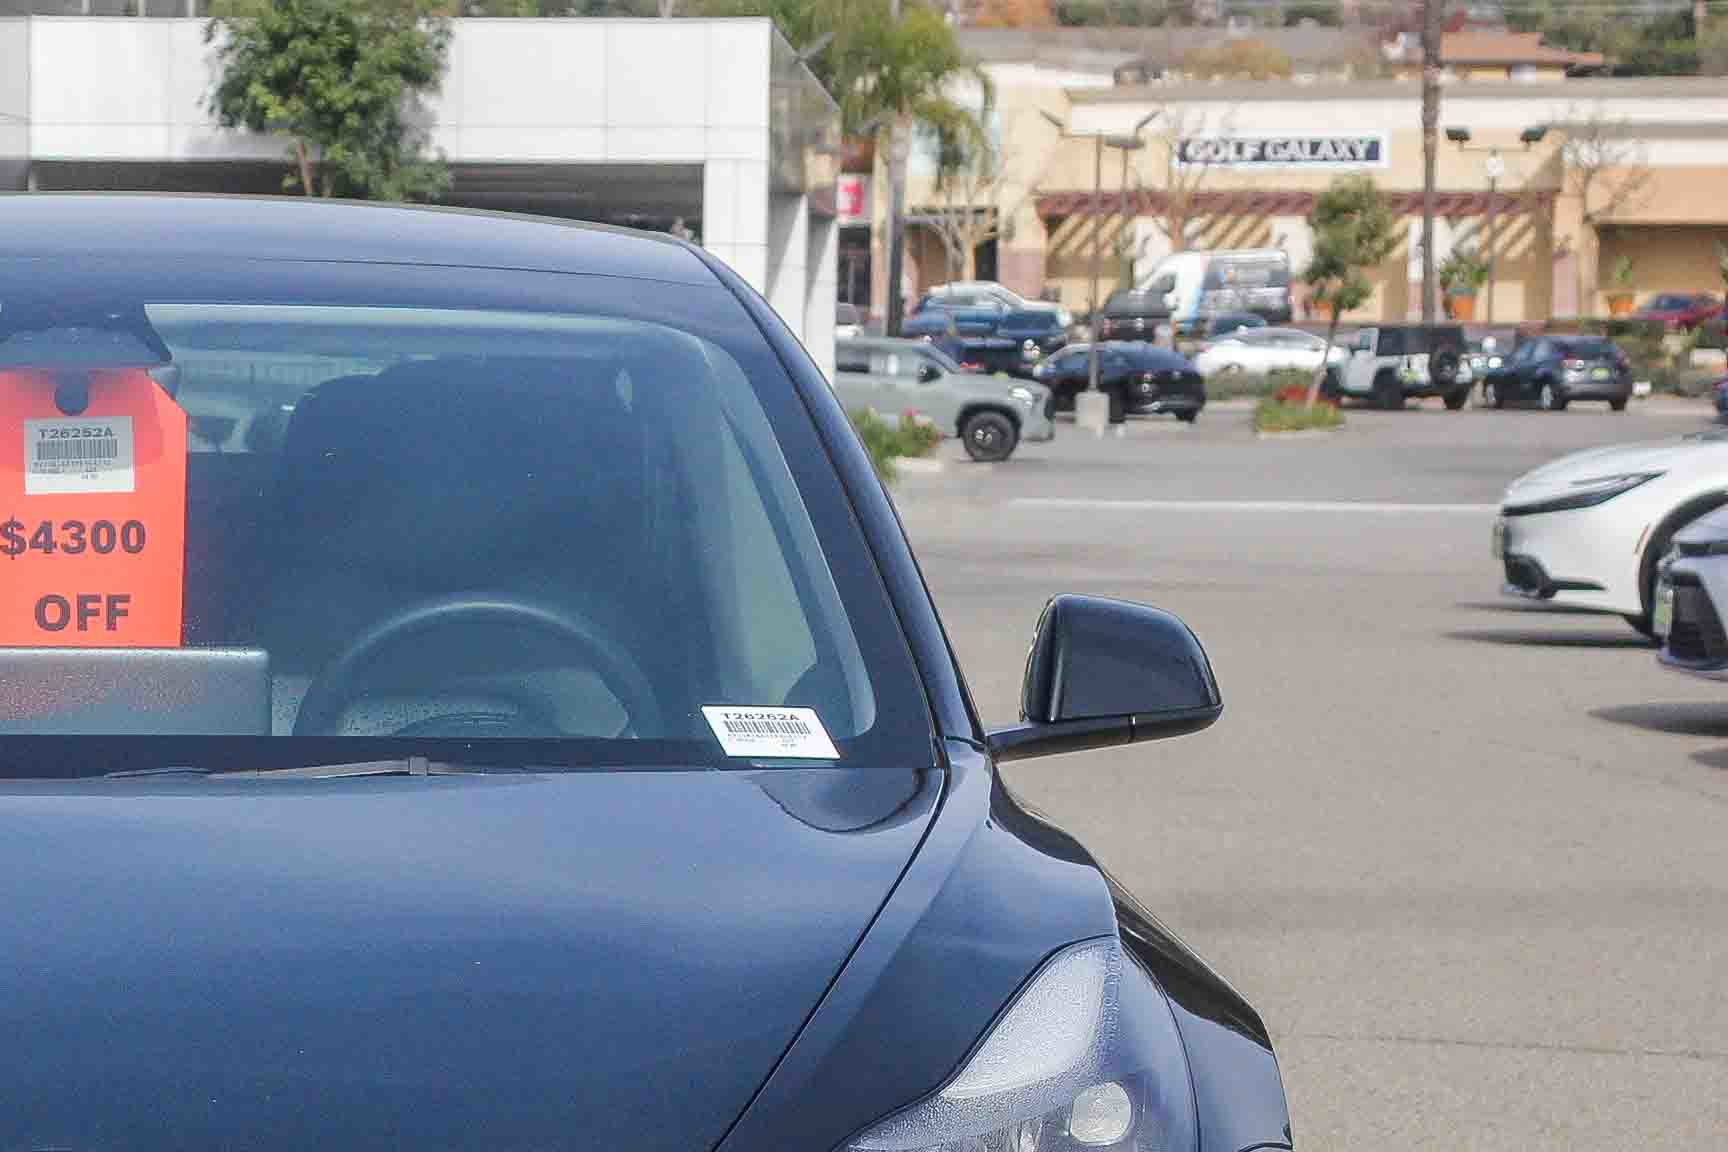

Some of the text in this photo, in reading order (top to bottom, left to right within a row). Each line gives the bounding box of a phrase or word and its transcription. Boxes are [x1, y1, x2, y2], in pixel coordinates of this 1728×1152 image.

[1185, 138, 1372, 162] GOLF GALAXY
[34, 593, 132, 632] OFF
